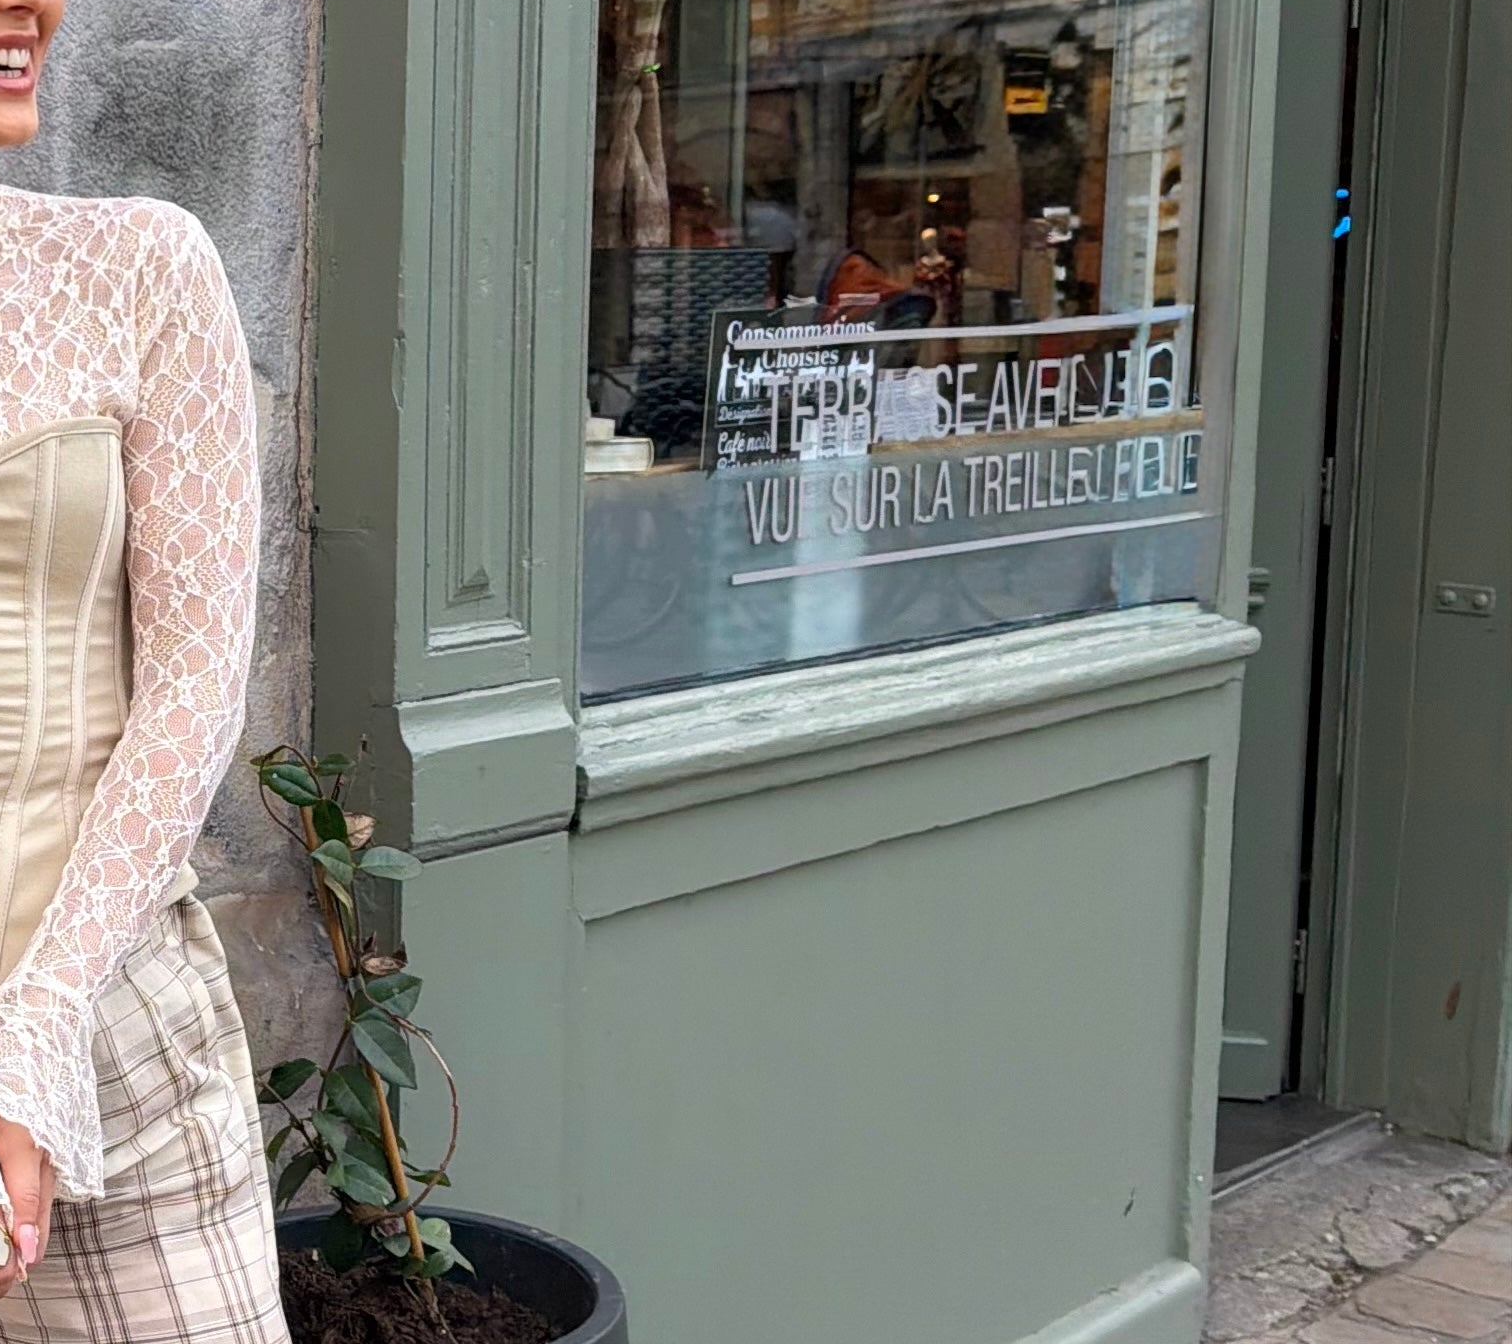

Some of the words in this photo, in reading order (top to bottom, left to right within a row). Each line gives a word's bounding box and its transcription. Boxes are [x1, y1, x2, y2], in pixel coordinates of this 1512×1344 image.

[727, 318, 876, 346] Consommations
[762, 346, 840, 369] Choisies
[829, 465, 901, 536] SUR
[913, 459, 955, 525] LA
